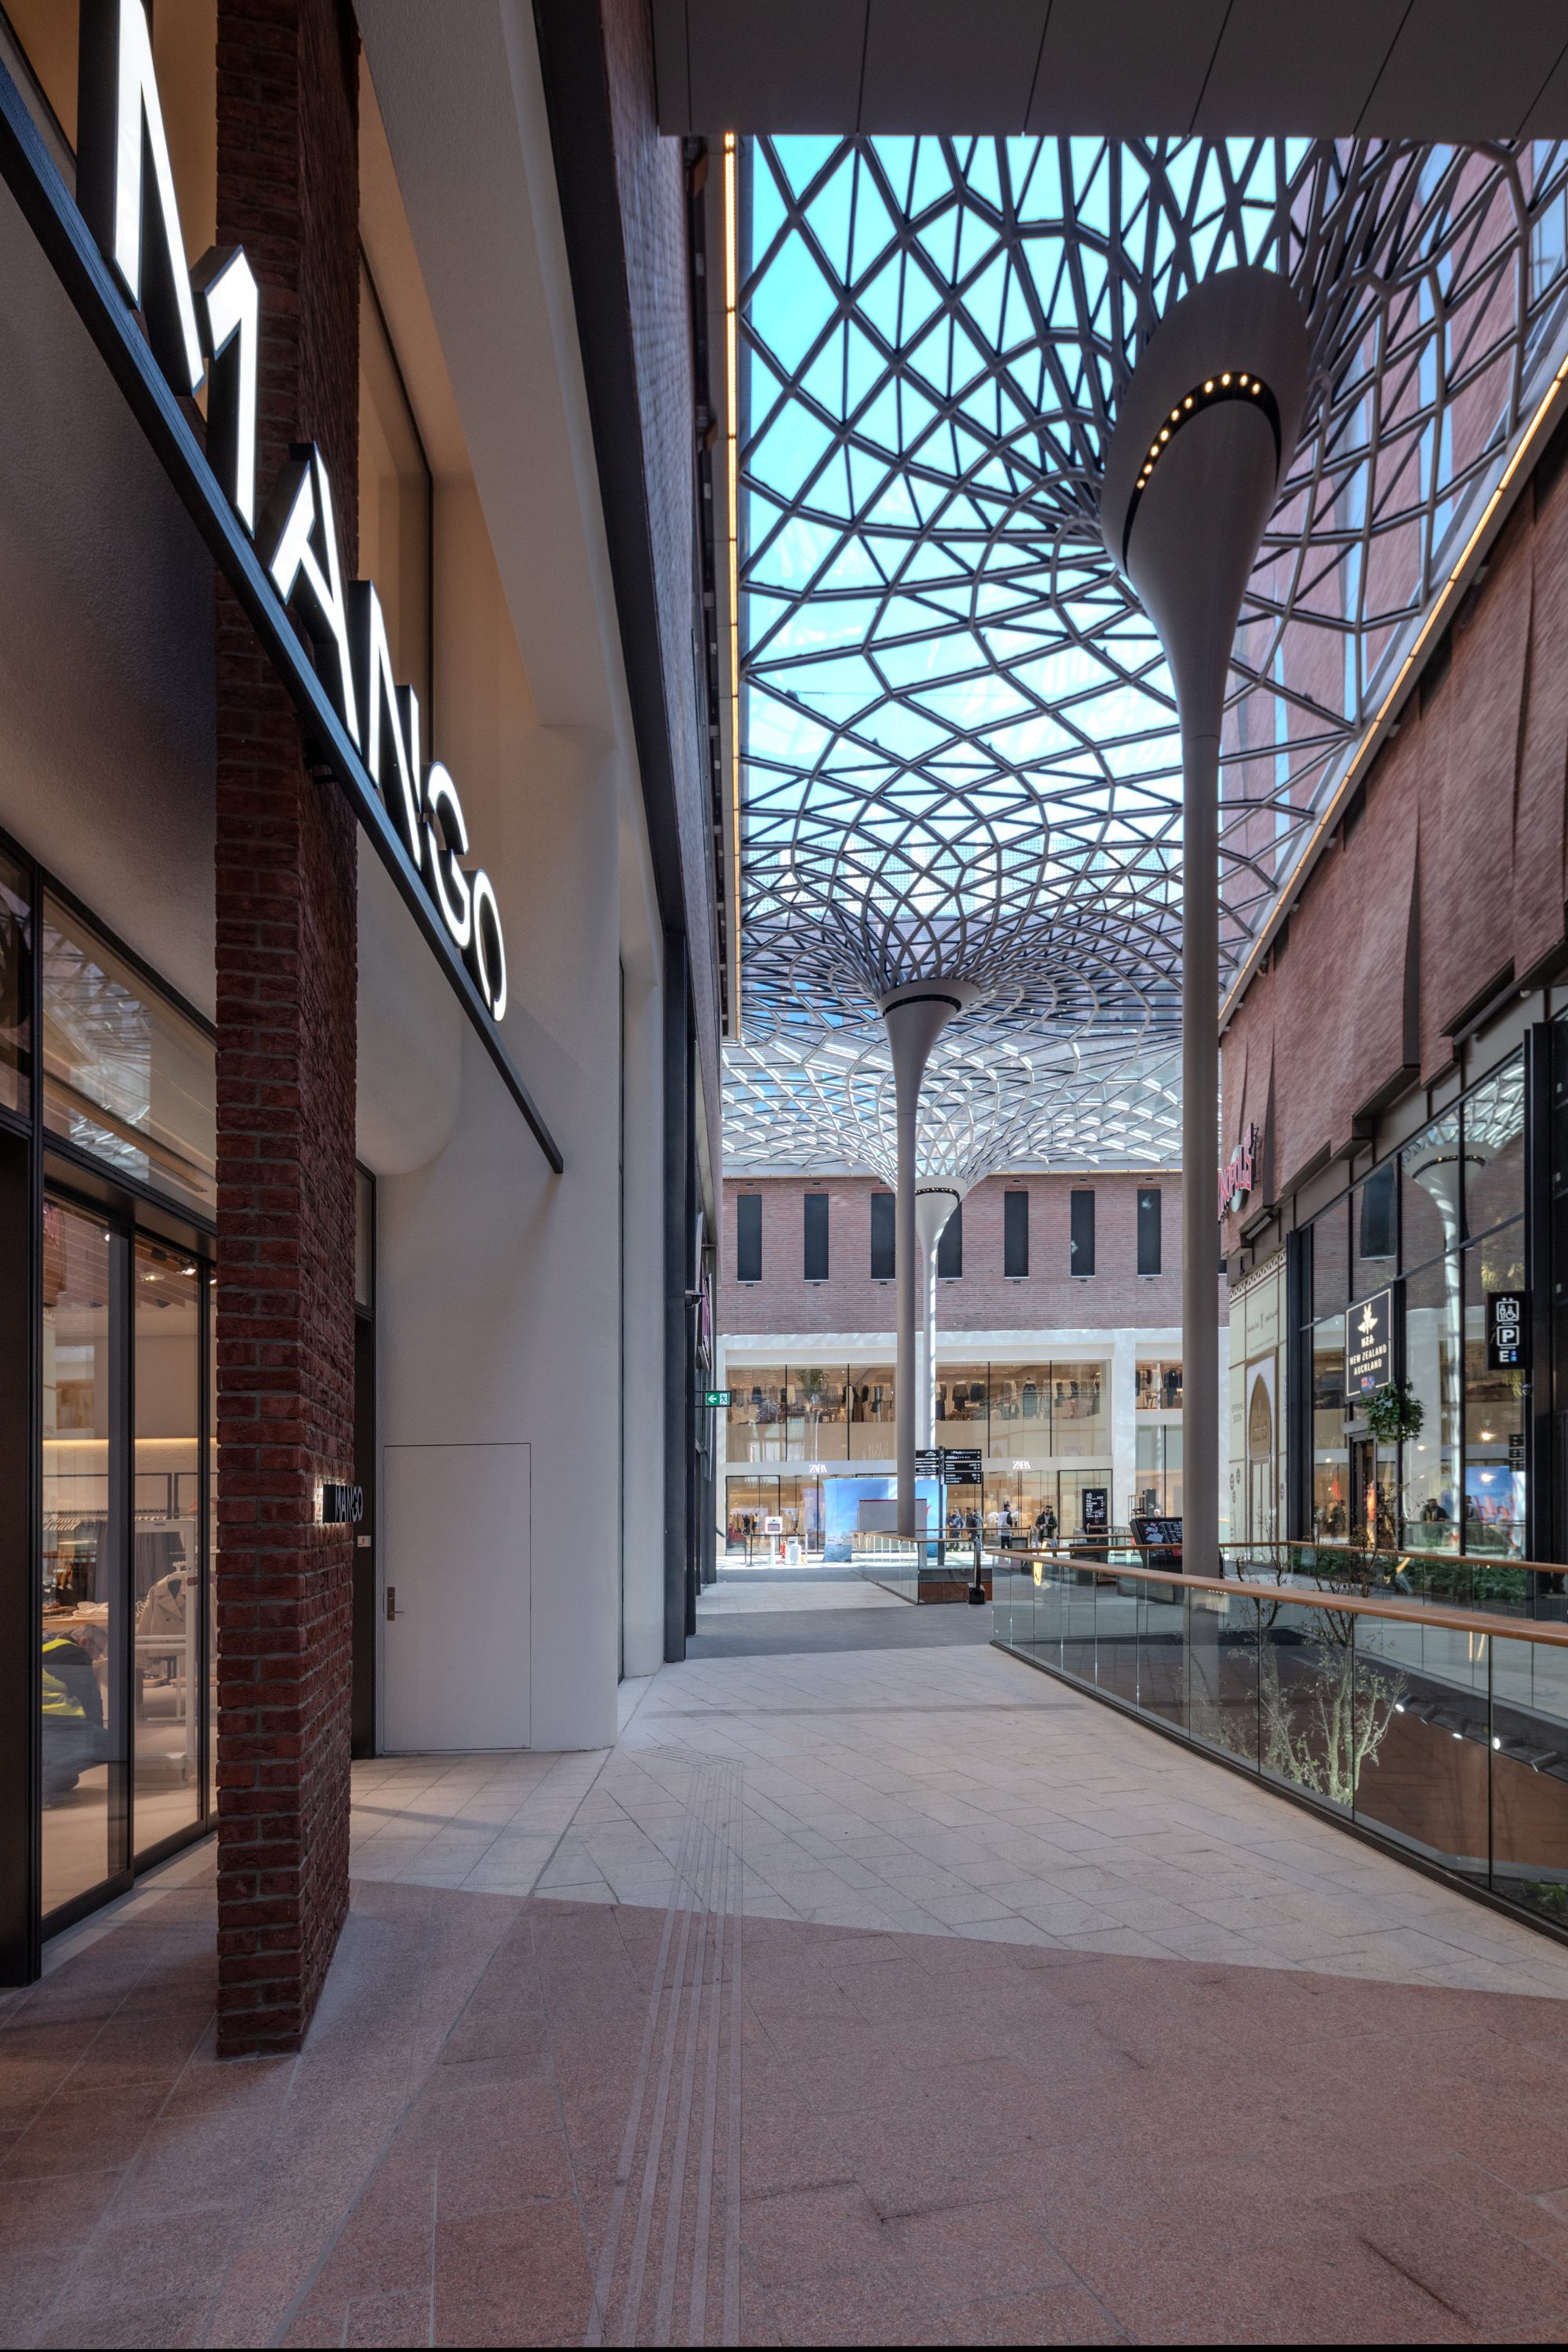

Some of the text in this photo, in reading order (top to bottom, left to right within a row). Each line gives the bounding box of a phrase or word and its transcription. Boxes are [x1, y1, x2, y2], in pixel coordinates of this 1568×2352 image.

[114, 0, 506, 1022] MANGO
[1501, 1329, 1515, 1343] P
[1349, 1344, 1388, 1366] NEW ZEALAND
[1499, 1350, 1510, 1363] E
[1353, 1358, 1382, 1376] AUCKLAND
[809, 1465, 828, 1473] ZARA
[1012, 1461, 1031, 1470] ZARA
[336, 1486, 363, 1523] MANGO
